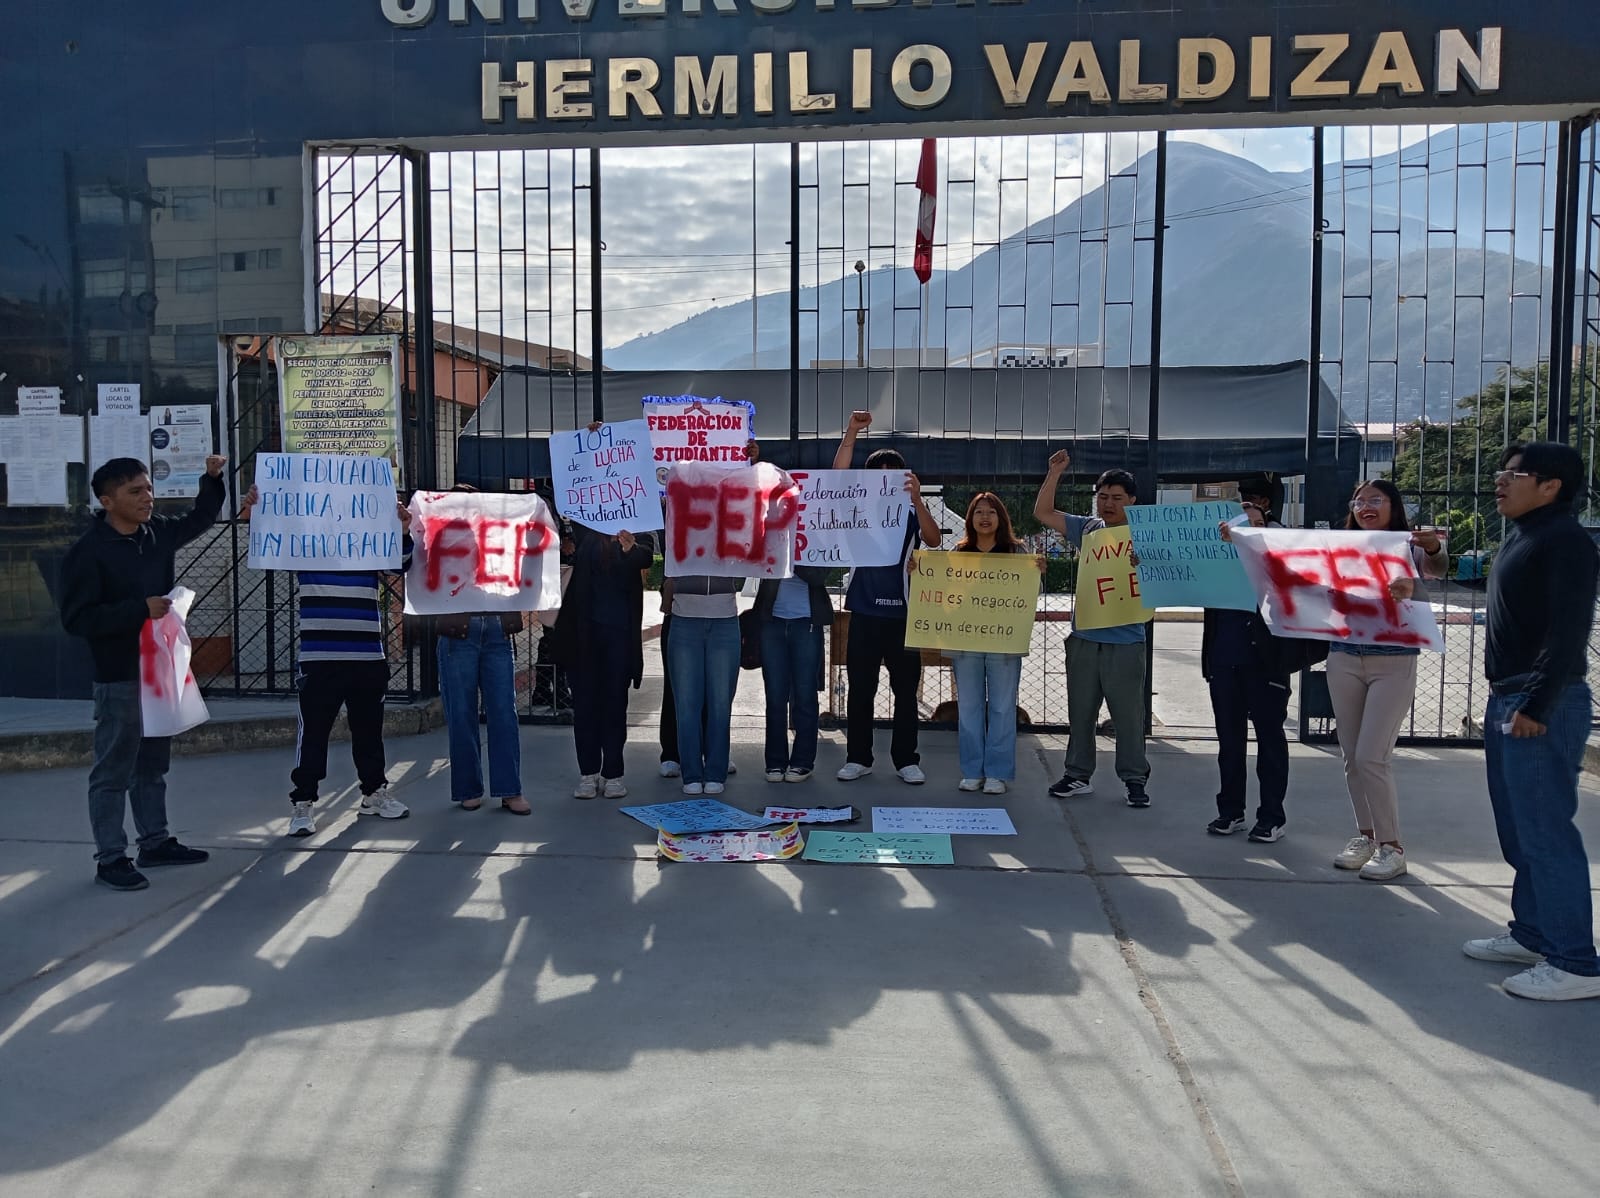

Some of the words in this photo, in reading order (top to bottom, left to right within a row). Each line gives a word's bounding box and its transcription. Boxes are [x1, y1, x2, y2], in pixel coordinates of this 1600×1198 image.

[481, 44, 952, 121] HERMILIO
[983, 27, 1502, 107] VALDIZAN
[318, 358, 346, 367] OFICIO
[353, 368, 375, 376] 2024
[293, 390, 330, 398] PERMITE
[331, 390, 341, 398] LA
[344, 387, 384, 397] REVISIÓN
[305, 380, 344, 388] UNHEVAL
[312, 400, 324, 408] DE
[325, 400, 366, 408] MOCHILA,
[342, 420, 387, 428] PERSONAL
[647, 411, 742, 431] FEDERACIÓN
[296, 441, 342, 450] DOCENTES,
[344, 440, 386, 448] ALUMNOS
[574, 425, 612, 455] 109
[687, 431, 708, 446] DE
[568, 458, 581, 472] de
[594, 446, 636, 468] LUCHA
[651, 446, 749, 462] STUDIANTES
[264, 456, 291, 480] SIN
[303, 457, 392, 487] EDUCACIÓN
[571, 475, 595, 488] por
[605, 465, 621, 478] la
[566, 476, 648, 505] DEFENSA
[879, 475, 897, 497] de
[351, 493, 379, 520] NO
[563, 498, 639, 522] estudiantil
[1129, 509, 1143, 524] DE
[1148, 508, 1159, 523] LA
[1163, 506, 1197, 522] COSTA
[1203, 505, 1212, 520] A
[1216, 504, 1233, 519] LA
[881, 504, 903, 529] del
[1132, 530, 1155, 543] SELVA
[1161, 528, 1172, 543] LA
[251, 531, 282, 557] HAY
[290, 531, 400, 559] DEMOCRACIA
[794, 532, 849, 562] Perú
[1134, 545, 1172, 560] PÚBLICA
[1178, 546, 1193, 560] ES
[920, 589, 943, 604] NO
[947, 593, 963, 605] es
[914, 619, 930, 631] es
[935, 621, 952, 632] un
[958, 621, 1014, 635] derecho
[769, 811, 807, 819] FEP
